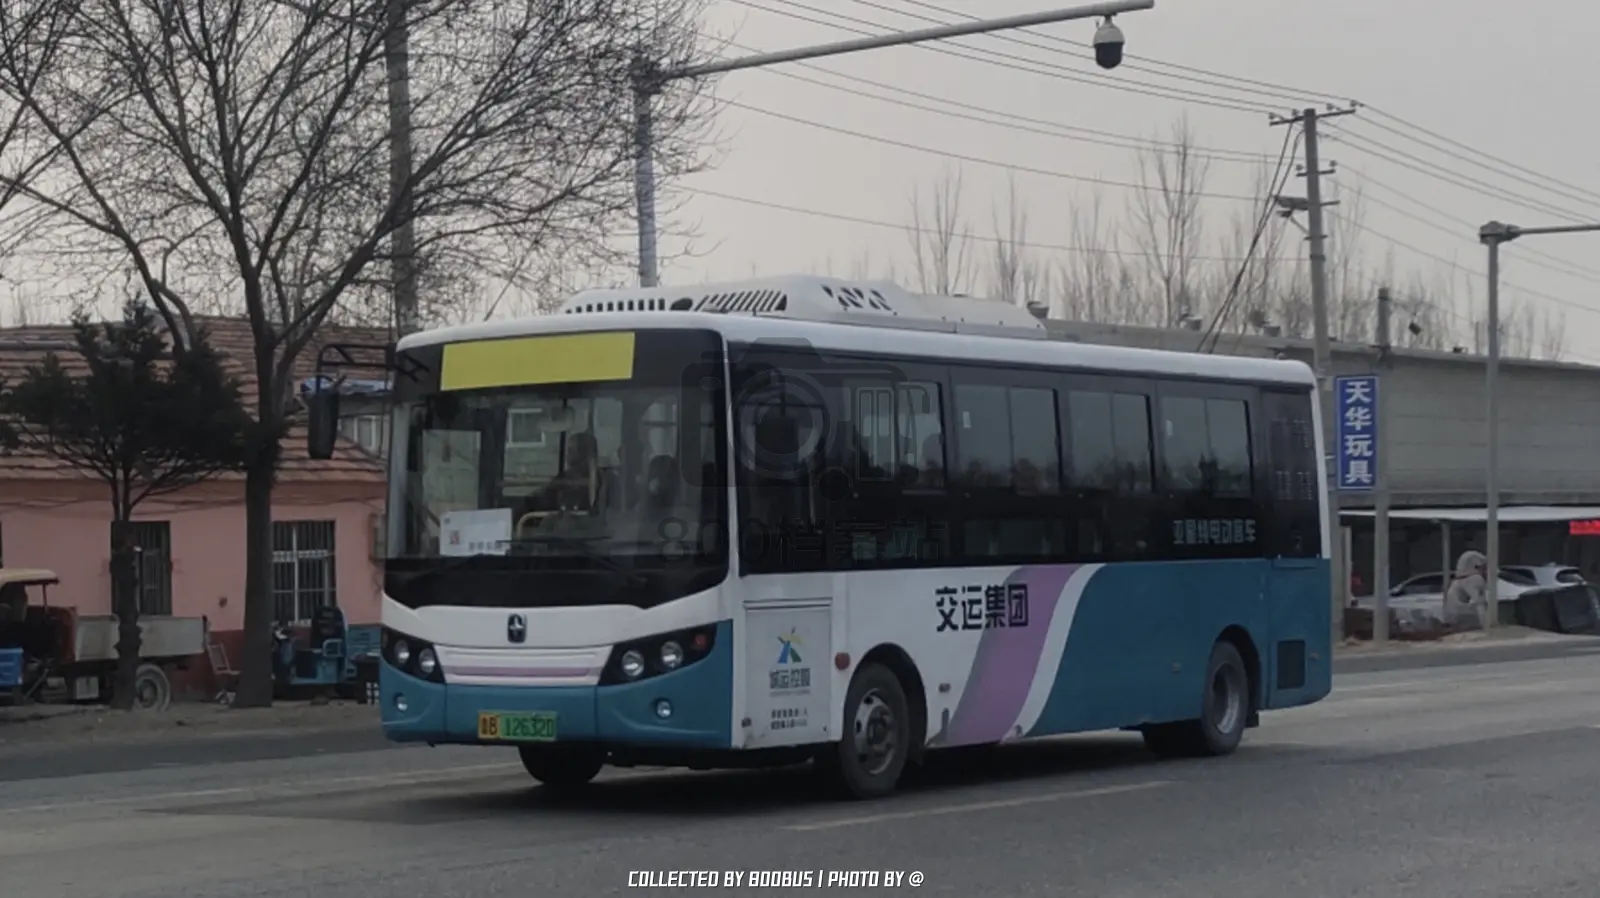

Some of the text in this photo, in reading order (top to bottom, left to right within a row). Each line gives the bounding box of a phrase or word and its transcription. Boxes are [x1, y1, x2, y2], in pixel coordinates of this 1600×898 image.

[1344, 380, 1373, 484] 天华玩具
[935, 583, 1029, 632] 交运集团
